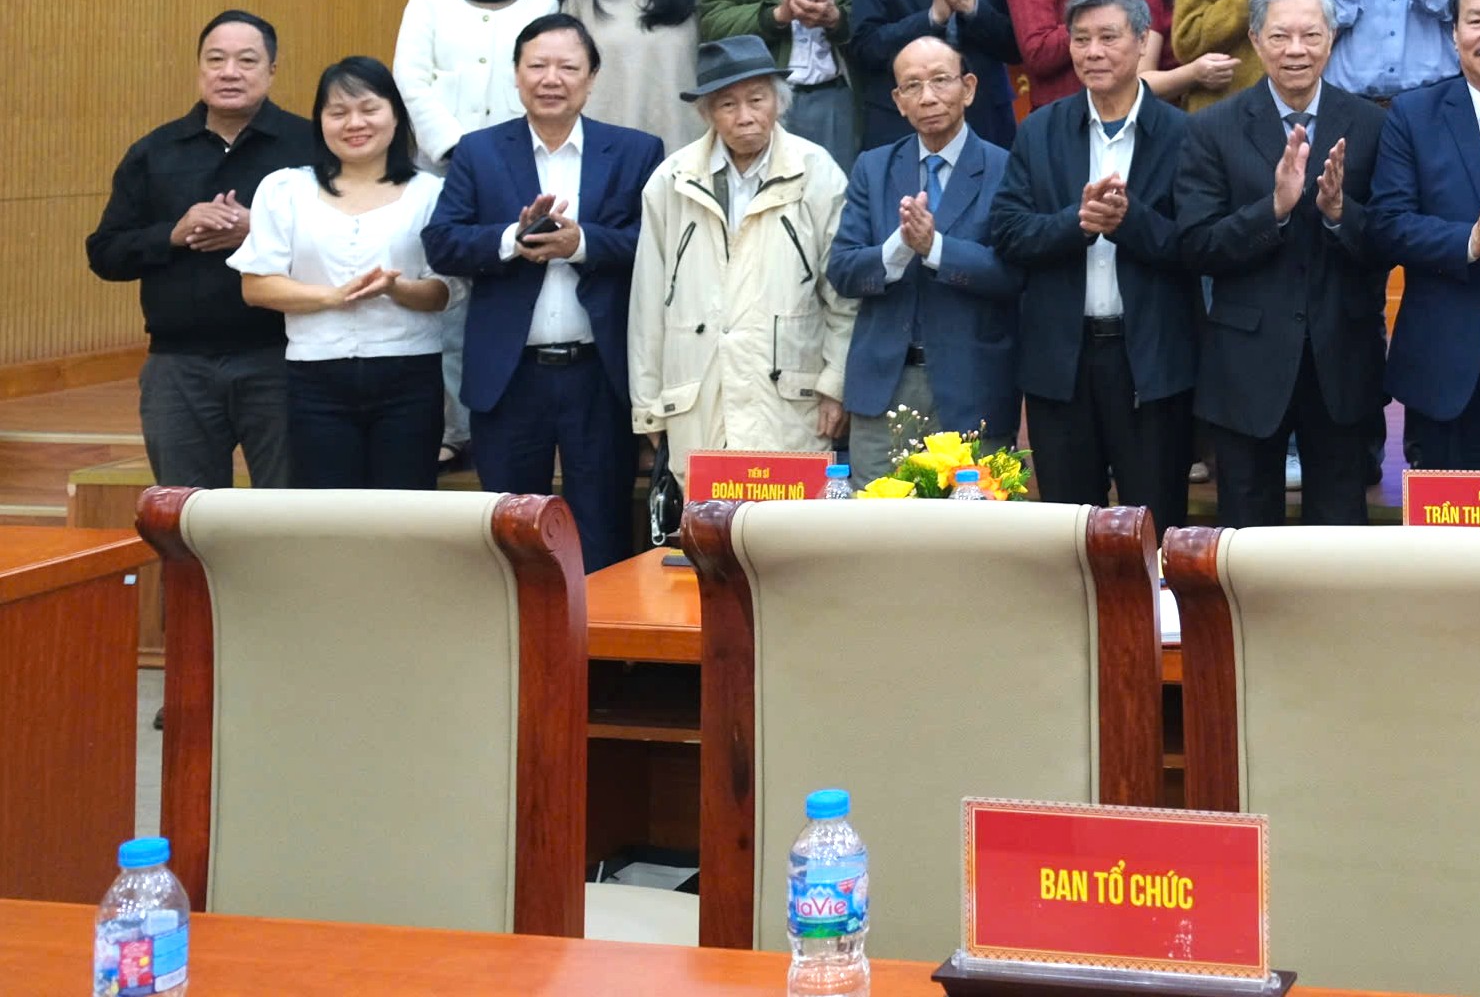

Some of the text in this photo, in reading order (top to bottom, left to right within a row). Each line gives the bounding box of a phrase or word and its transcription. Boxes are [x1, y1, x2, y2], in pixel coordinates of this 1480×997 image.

[712, 479, 743, 499] ĐOÀN
[746, 483, 785, 500] THANH
[1423, 501, 1459, 524] TRẦN
[1040, 859, 1194, 910] BAN TỔ CHỨC
